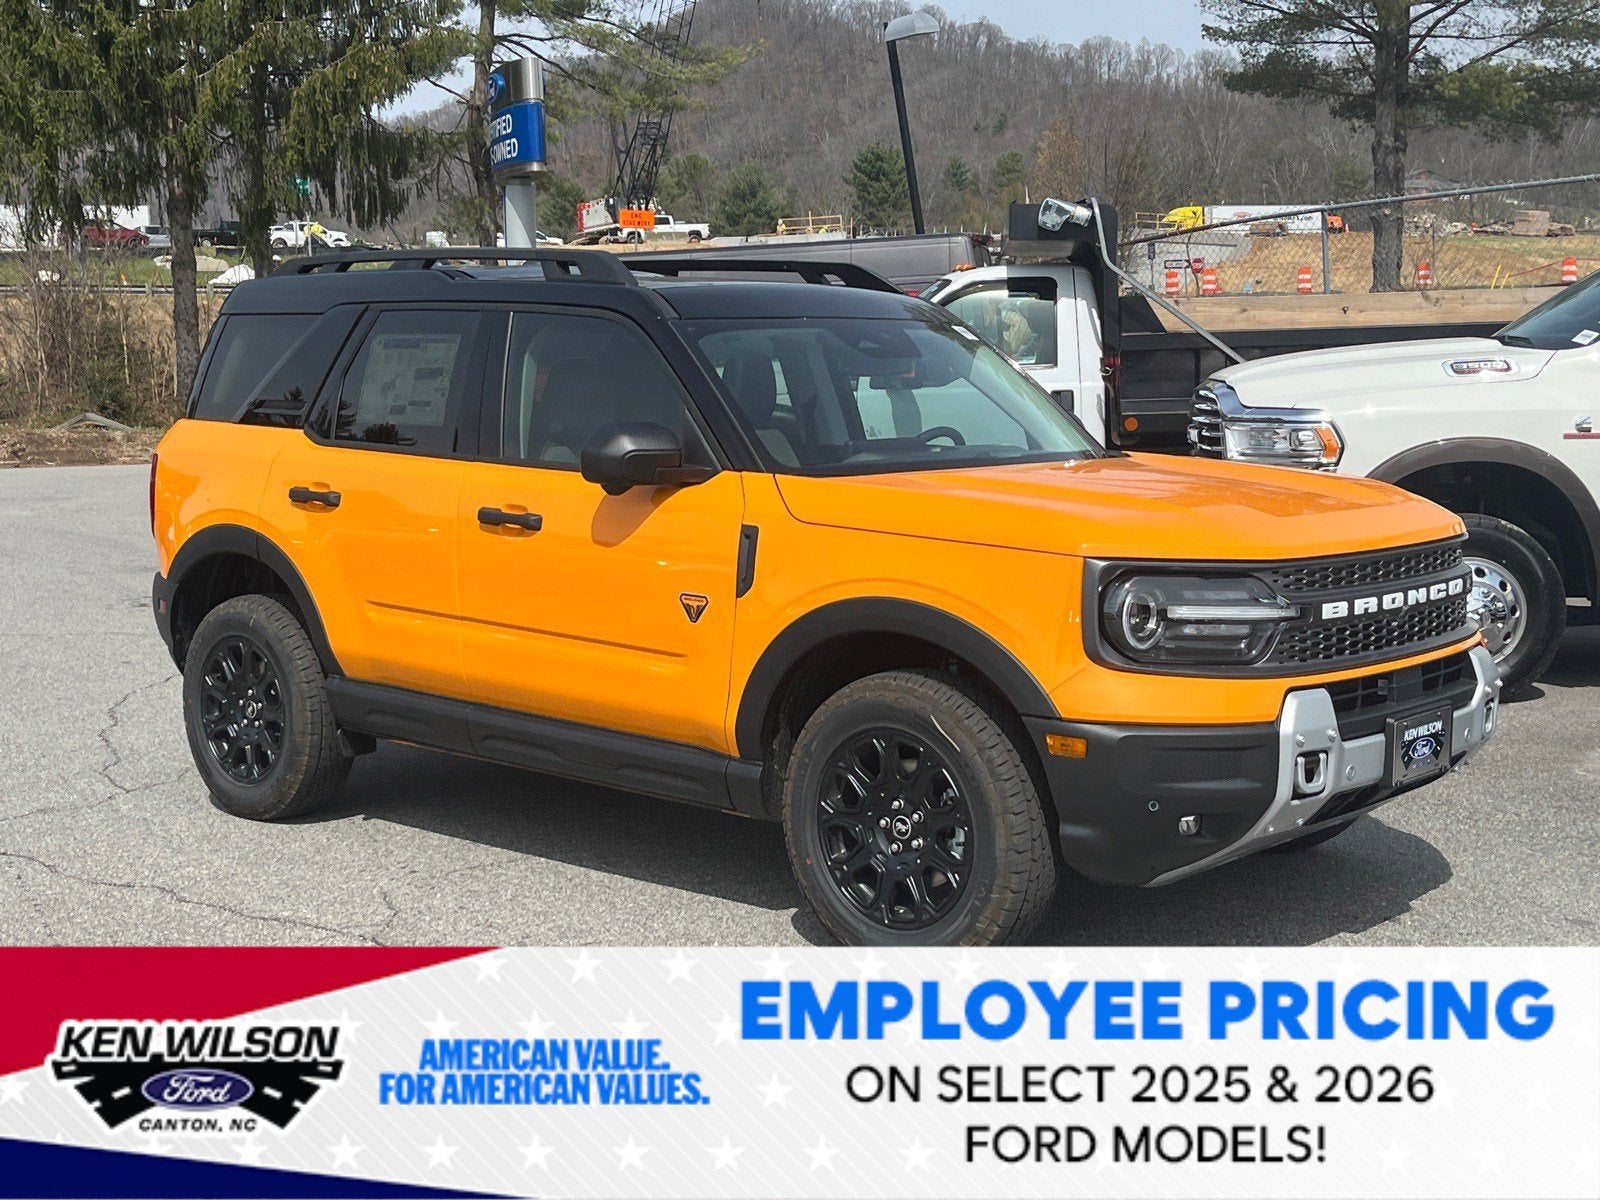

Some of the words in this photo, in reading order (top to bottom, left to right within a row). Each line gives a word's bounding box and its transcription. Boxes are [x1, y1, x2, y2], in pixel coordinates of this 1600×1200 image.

[1321, 578, 1464, 620] BRONCO
[1404, 728, 1418, 741] KEN
[1418, 720, 1443, 737] WILSON
[1414, 740, 1432, 757] Ford
